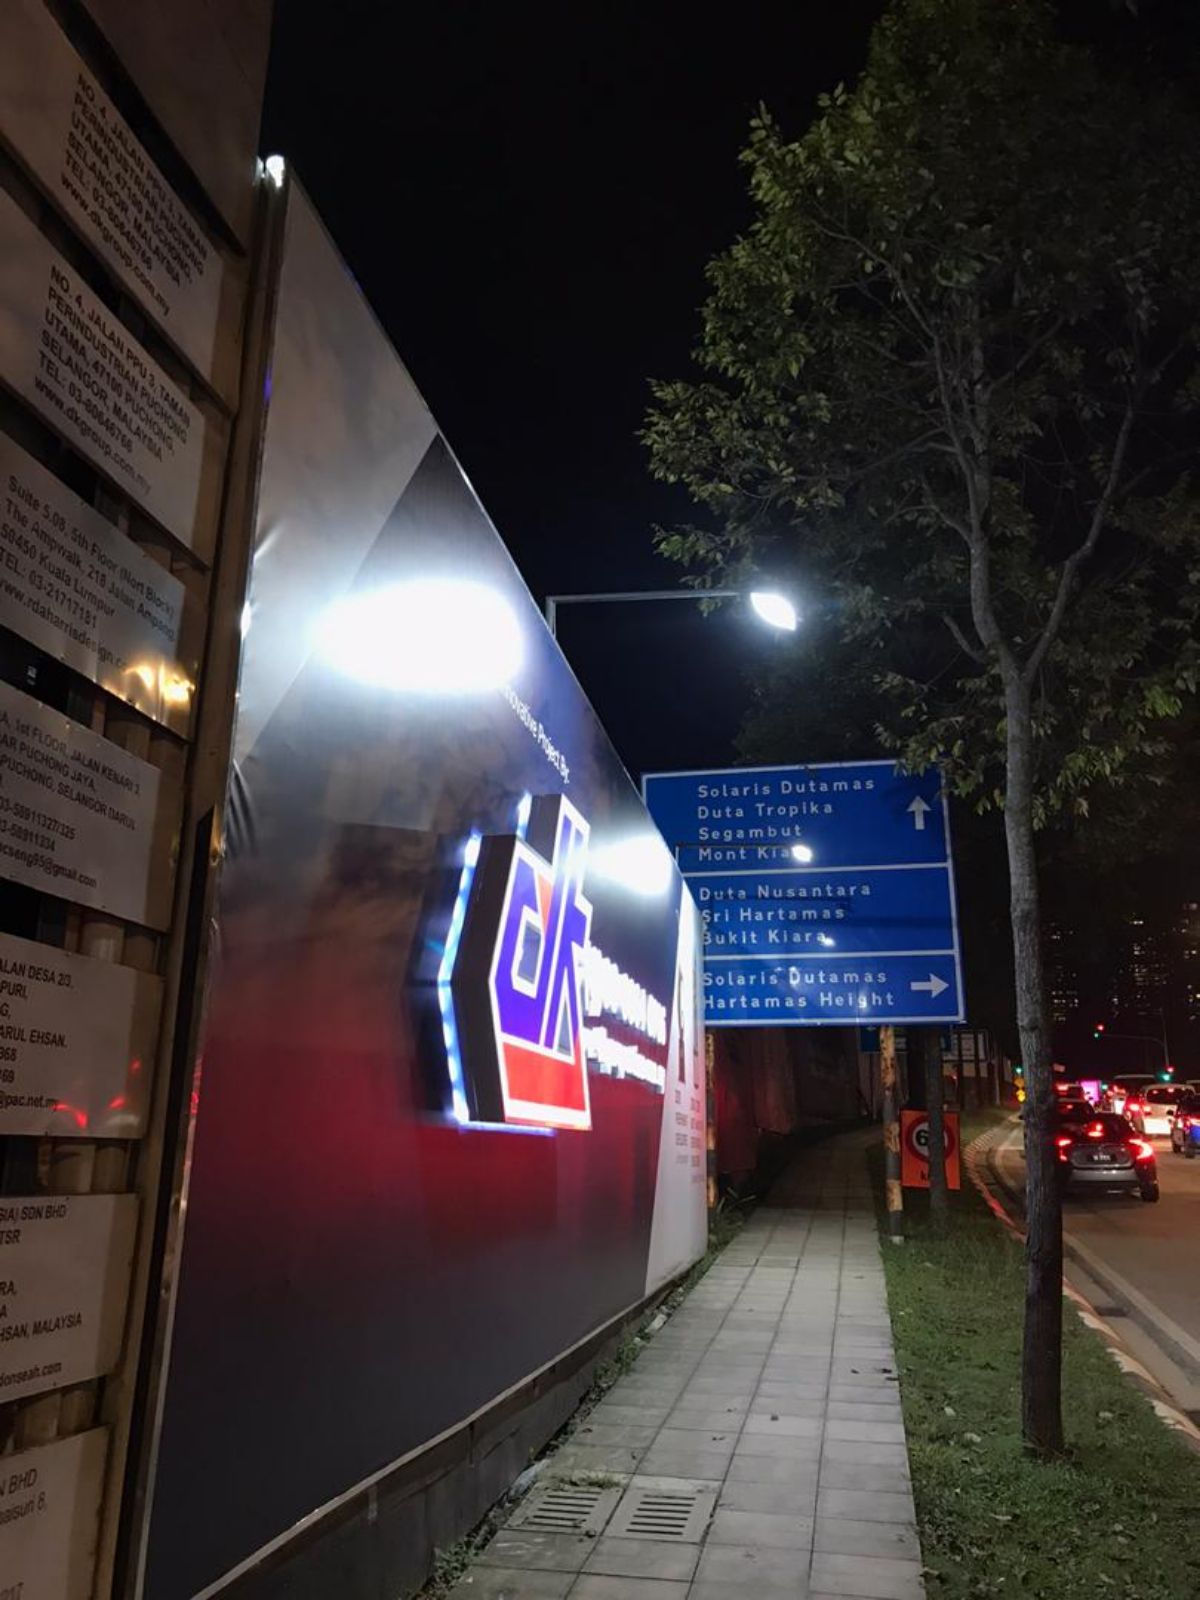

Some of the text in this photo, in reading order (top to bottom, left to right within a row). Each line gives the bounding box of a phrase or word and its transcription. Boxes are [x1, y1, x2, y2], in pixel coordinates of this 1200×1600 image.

[47, 286, 187, 444] PERINDUSTRIAN PUCHONG
[87, 306, 123, 353] JALAN
[125, 347, 147, 379] PPU
[158, 384, 189, 426] TAMAN
[40, 329, 161, 461] SELANGOR, MALAYSIA
[4, 496, 28, 526] The
[8, 474, 39, 511] Suite
[70, 527, 89, 551] 5th
[90, 542, 116, 573] Floor
[37, 550, 73, 588] Kuala
[73, 578, 115, 620] Lumpur
[538, 722, 561, 771] Project
[19, 741, 69, 778] PUCHONG
[71, 750, 100, 773] JALAN
[57, 783, 107, 817] SELANGOR
[697, 779, 875, 799] Solaris Dutamas
[697, 802, 833, 820] Duta Tropika
[698, 824, 803, 842] Segambut
[699, 847, 748, 862] Mont
[699, 883, 872, 901] Duta Nusantara
[701, 906, 846, 923] Sri Hartamas
[768, 929, 827, 945] Kiara
[28, 964, 56, 983] DESA
[704, 967, 888, 987] Solaris Dutamas
[704, 991, 896, 1010] Hartamas Height
[20, 1205, 43, 1220] SDN
[44, 1203, 66, 1219] BHD
[32, 1311, 82, 1336] MALAYSIA
[8, 1468, 38, 1495] BHD
